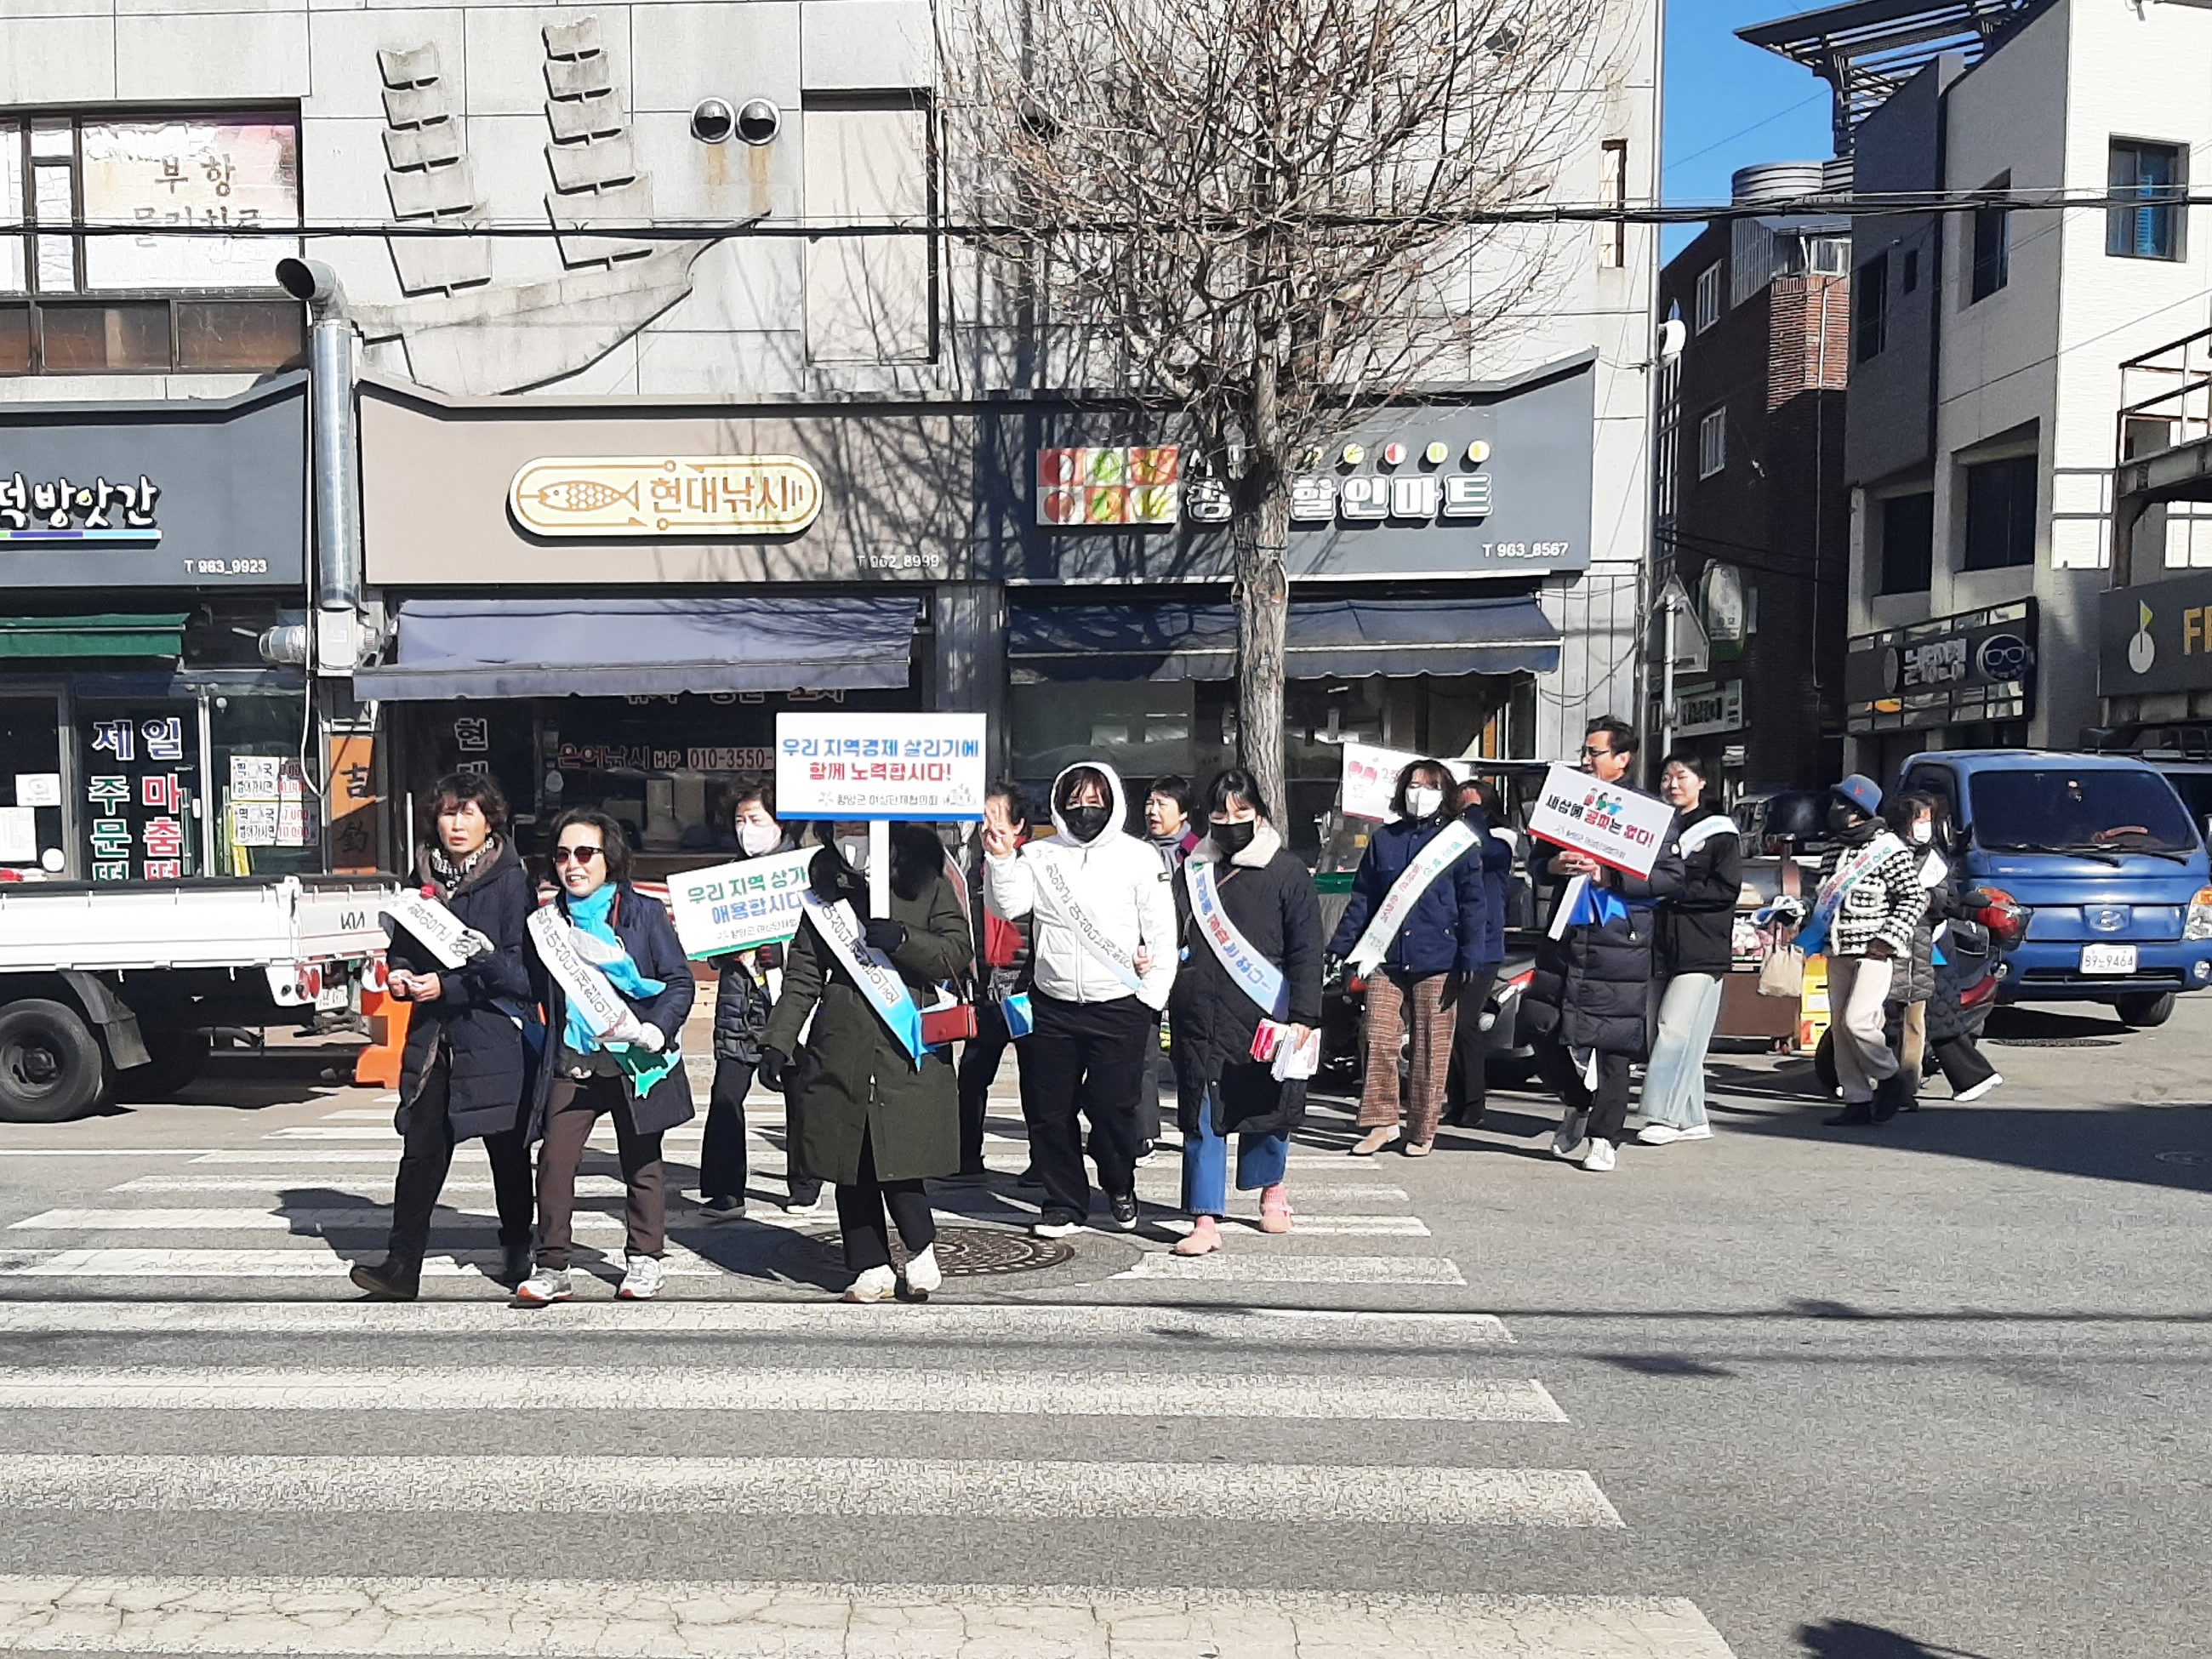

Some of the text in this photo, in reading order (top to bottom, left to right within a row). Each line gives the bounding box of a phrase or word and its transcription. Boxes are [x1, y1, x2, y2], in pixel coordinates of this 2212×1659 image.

[650, 476, 788, 513] 현대낚시
[1186, 473, 1493, 522] 할인마트
[1482, 543, 1569, 559] T 963_8567
[184, 559, 194, 573] T
[91, 718, 182, 760] 제일
[782, 738, 980, 757] 우리 지역경제 살리기에
[809, 761, 952, 782] 함께 노력합시다!
[687, 881, 725, 904] 우리
[728, 875, 766, 896] 지역
